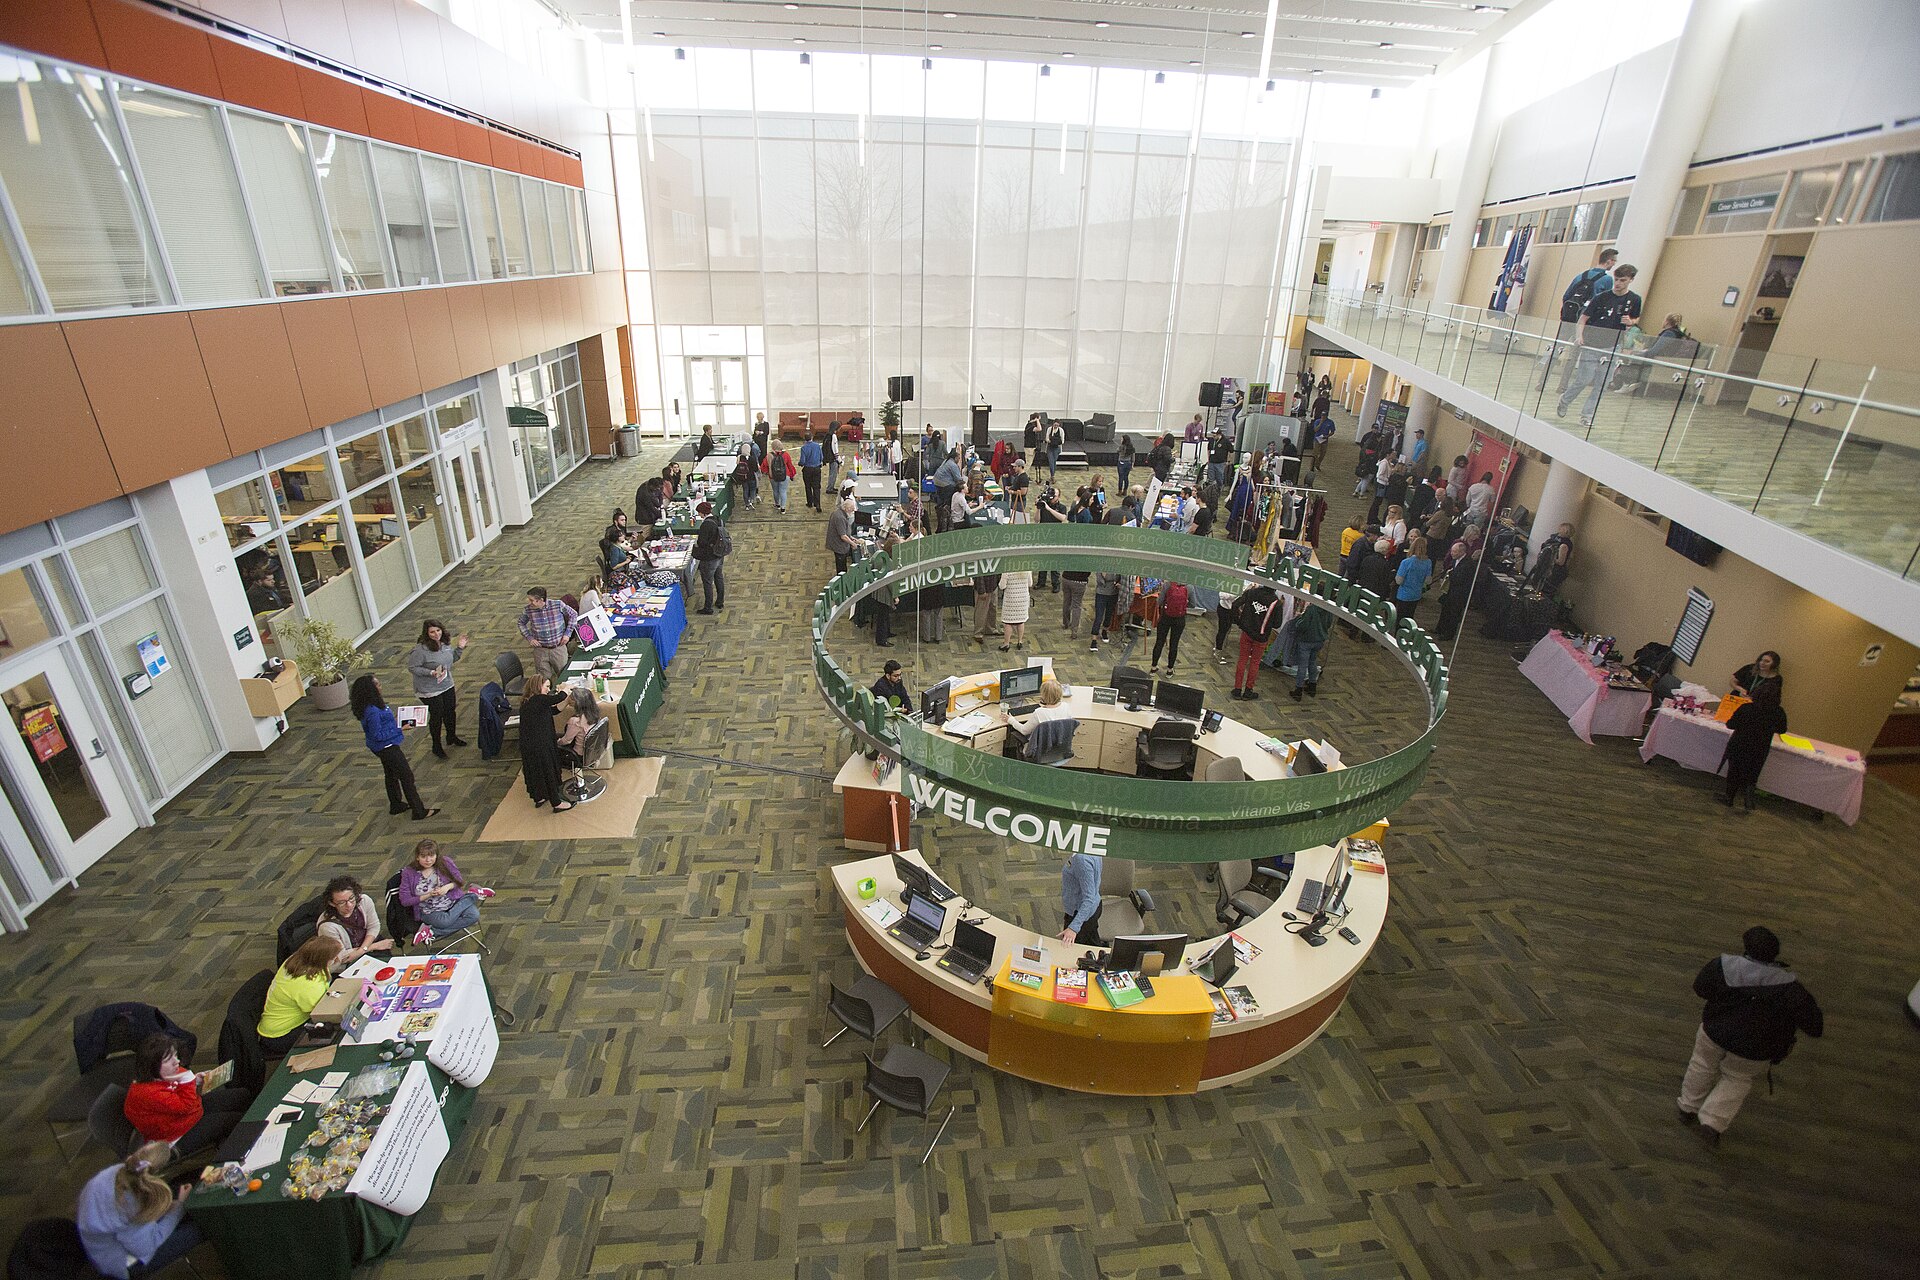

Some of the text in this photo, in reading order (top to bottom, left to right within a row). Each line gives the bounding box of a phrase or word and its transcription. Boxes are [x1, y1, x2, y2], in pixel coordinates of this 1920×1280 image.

[1732, 201, 1750, 210] Services
[1750, 199, 1765, 208] Center
[908, 773, 1111, 856] WELCOME
[367, 1164, 379, 1183] Please
[377, 1151, 386, 1164] help
[384, 1130, 396, 1151] support
[395, 1114, 405, 1130] young
[403, 1098, 412, 1114] adults
[372, 1157, 389, 1188] disabilities
[392, 1131, 400, 1146] their
[381, 1169, 400, 1201] community
[399, 1148, 409, 1168] outings
[411, 1113, 426, 1138] overnight
[384, 1171, 393, 1187] items
[392, 1156, 400, 1171] made
[402, 1126, 413, 1148] students
[414, 1109, 422, 1120] help
[420, 1095, 429, 1109] fund
[408, 1151, 417, 1172] advance
